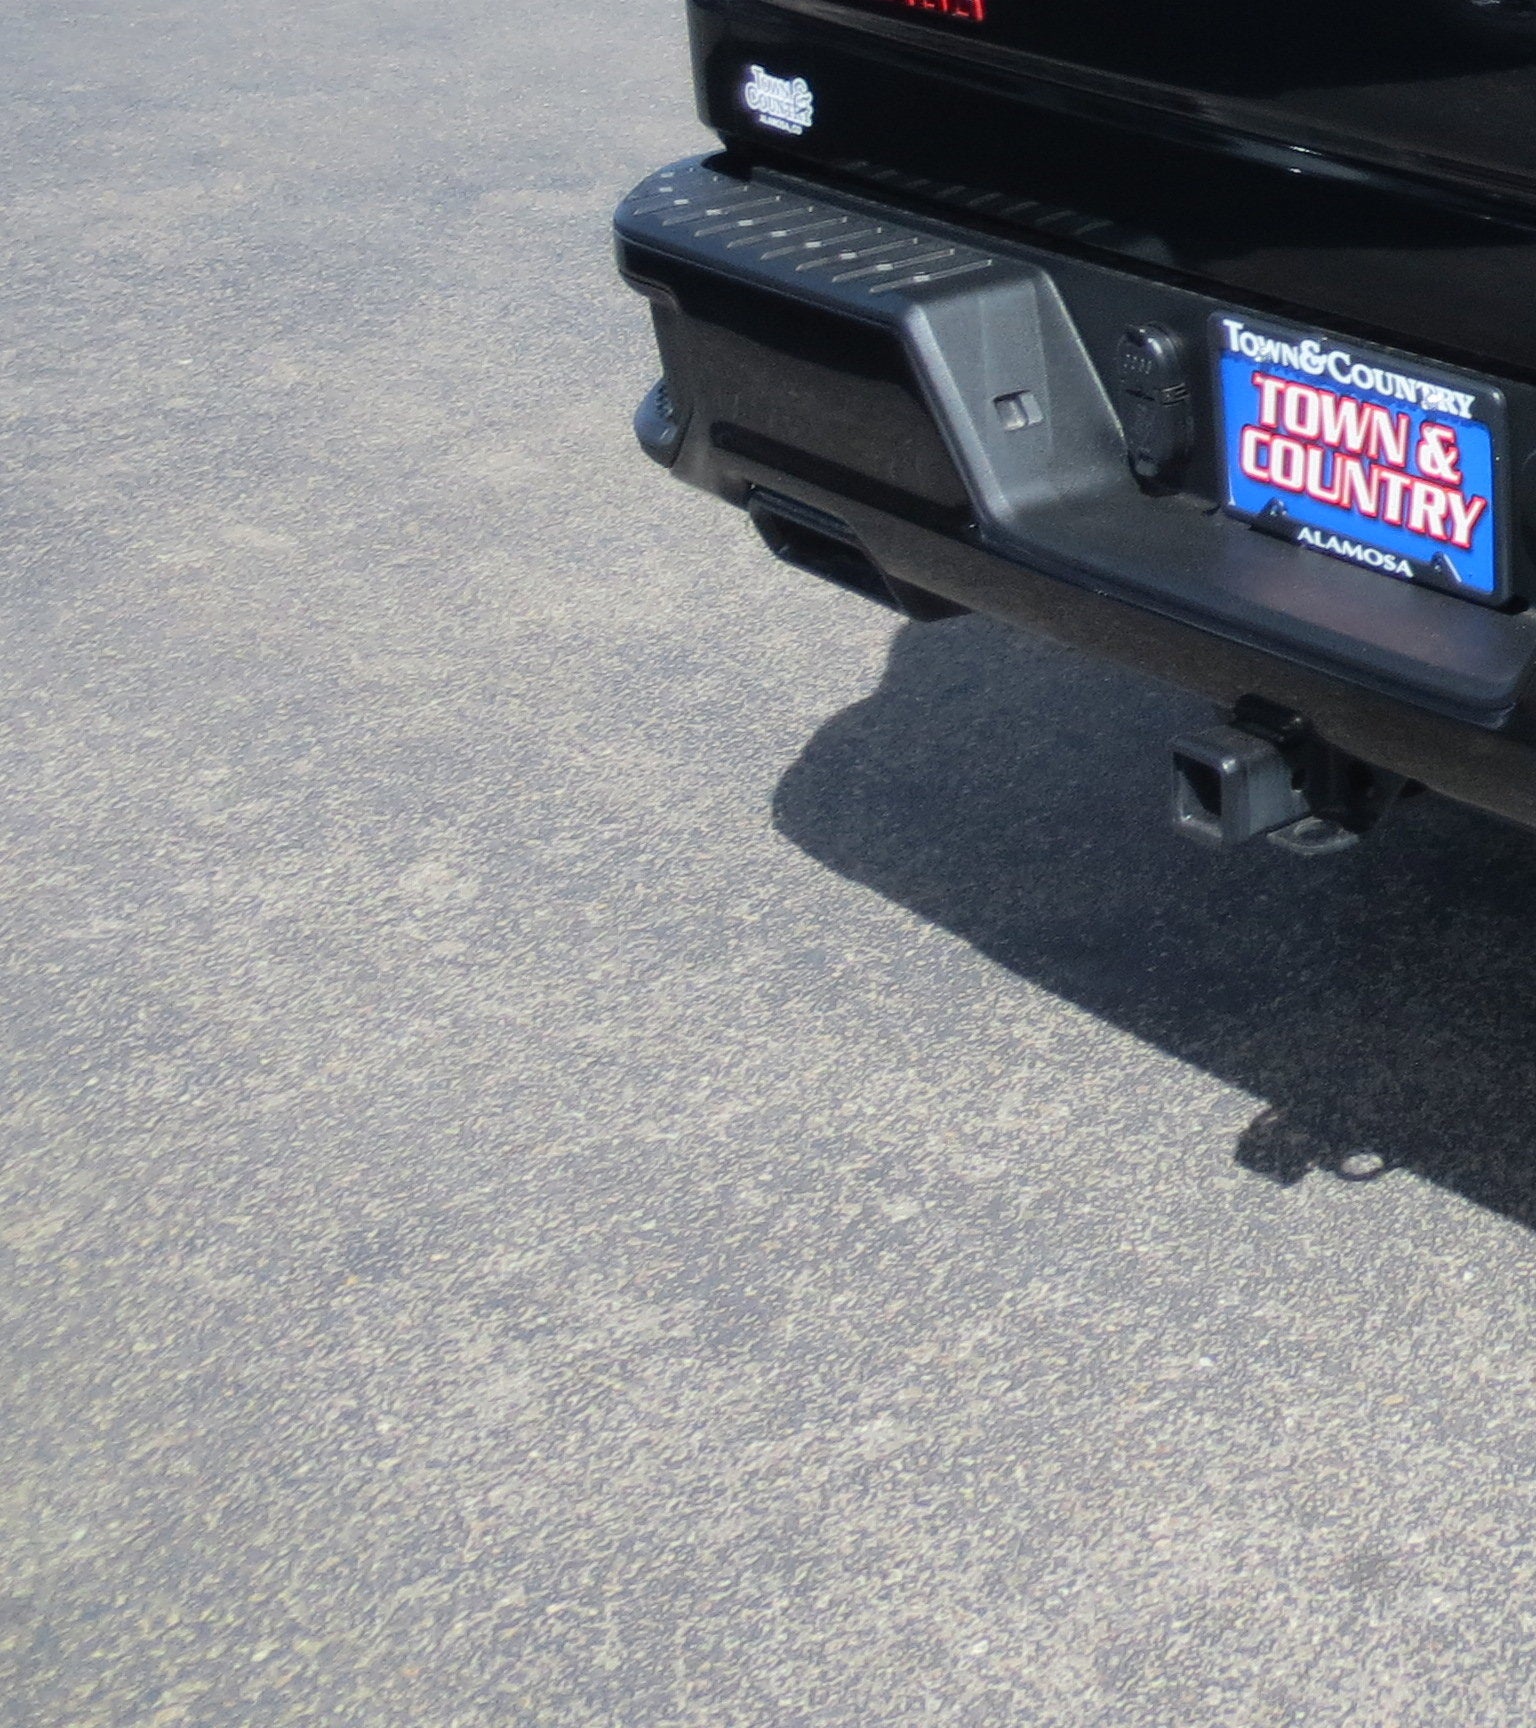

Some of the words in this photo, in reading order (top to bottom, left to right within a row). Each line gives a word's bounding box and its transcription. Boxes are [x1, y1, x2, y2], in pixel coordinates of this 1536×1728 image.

[1251, 371, 1411, 468] TOWN
[1417, 420, 1463, 485] &
[1240, 423, 1488, 551] COUNTRY
[1296, 526, 1415, 579] ALAMOSA
